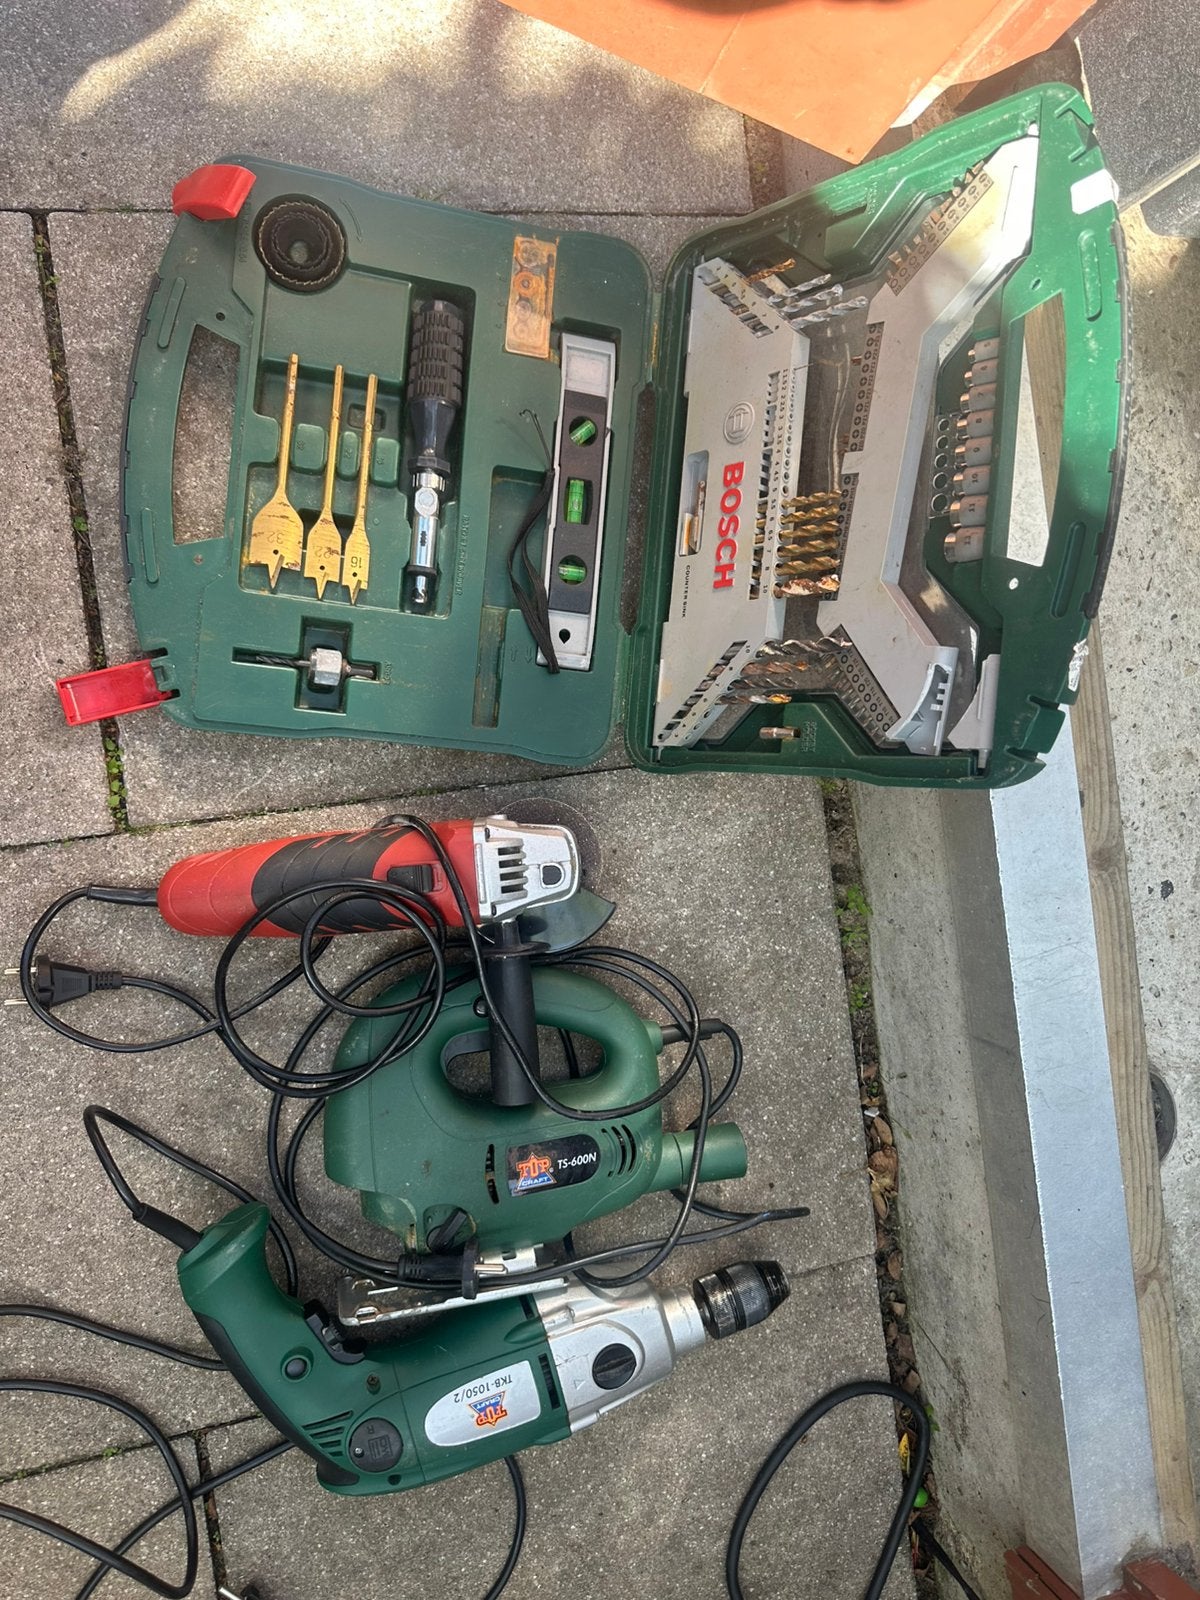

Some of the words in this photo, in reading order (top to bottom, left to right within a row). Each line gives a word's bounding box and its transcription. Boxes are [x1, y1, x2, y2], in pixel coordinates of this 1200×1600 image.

[713, 461, 745, 589] BOSCH
[266, 531, 284, 545] 32
[315, 546, 331, 559] 22
[350, 556, 362, 568] 16
[516, 1153, 552, 1179] TOP
[557, 1152, 597, 1170] TS-600N
[521, 1176, 549, 1186] CRAFT
[453, 1374, 513, 1403] TKB-1050/2
[476, 1396, 501, 1409] CRAFT
[476, 1406, 508, 1426] TOP
